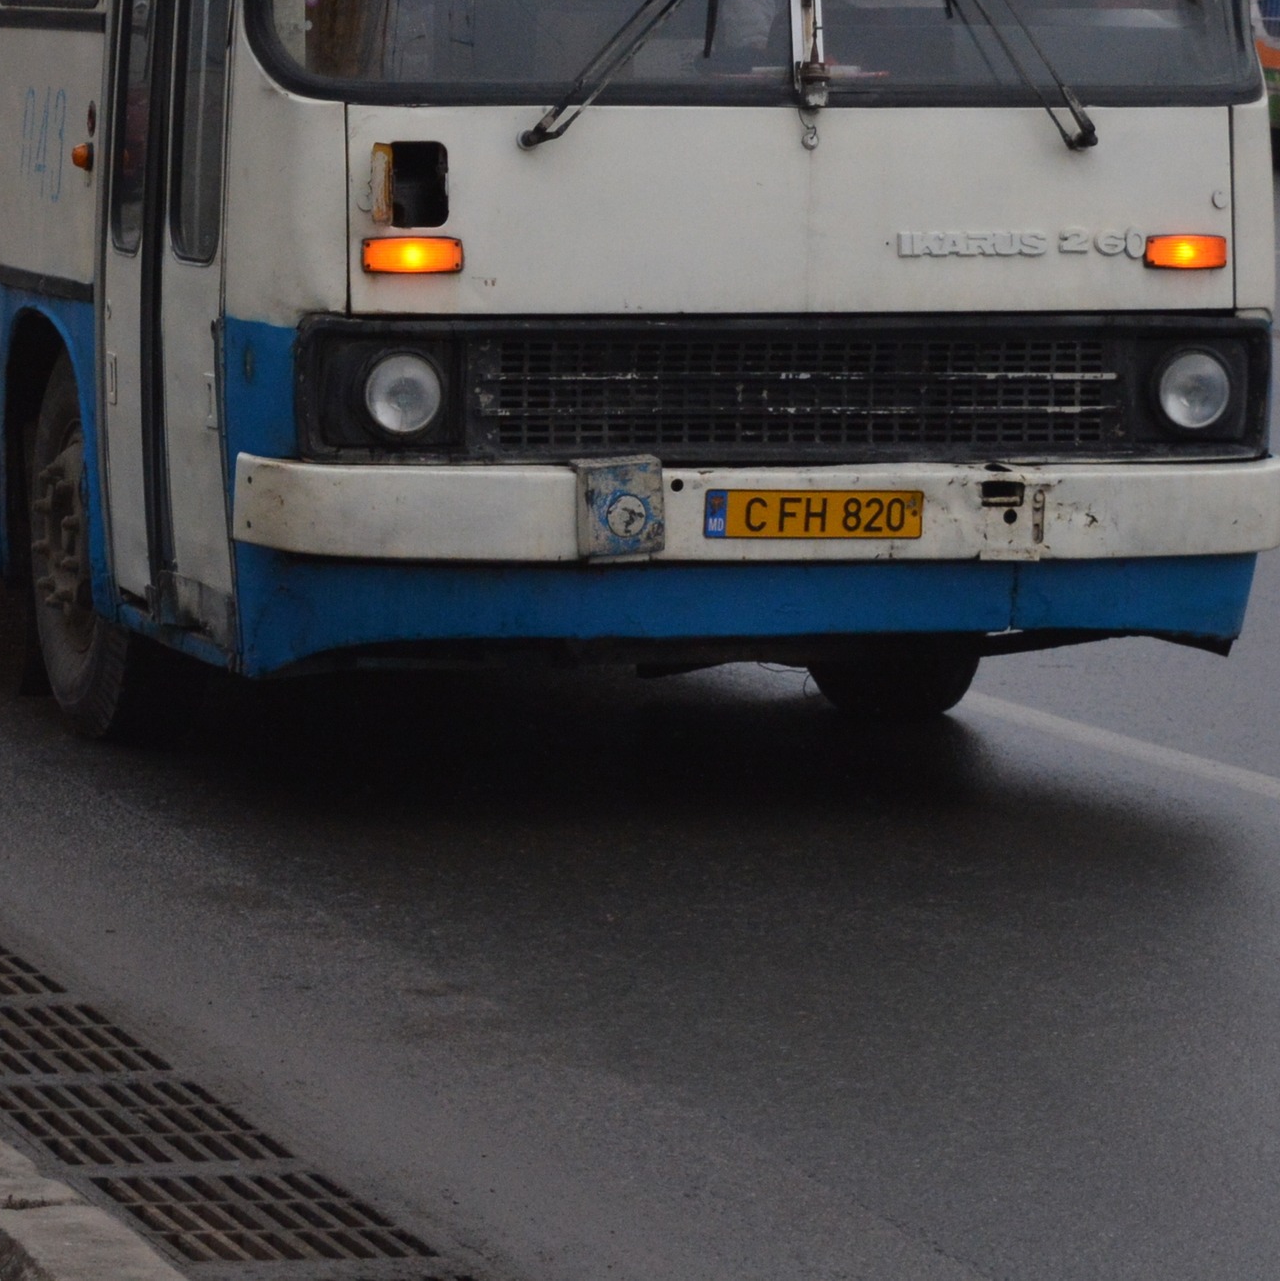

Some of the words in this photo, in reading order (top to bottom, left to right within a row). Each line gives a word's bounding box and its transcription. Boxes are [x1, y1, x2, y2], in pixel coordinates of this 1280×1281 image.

[898, 232, 1047, 258] IKARUS
[1058, 226, 1145, 260] 260
[708, 517, 724, 532] MD
[745, 497, 768, 532] C
[778, 497, 828, 532] FH
[842, 497, 906, 532] 820
